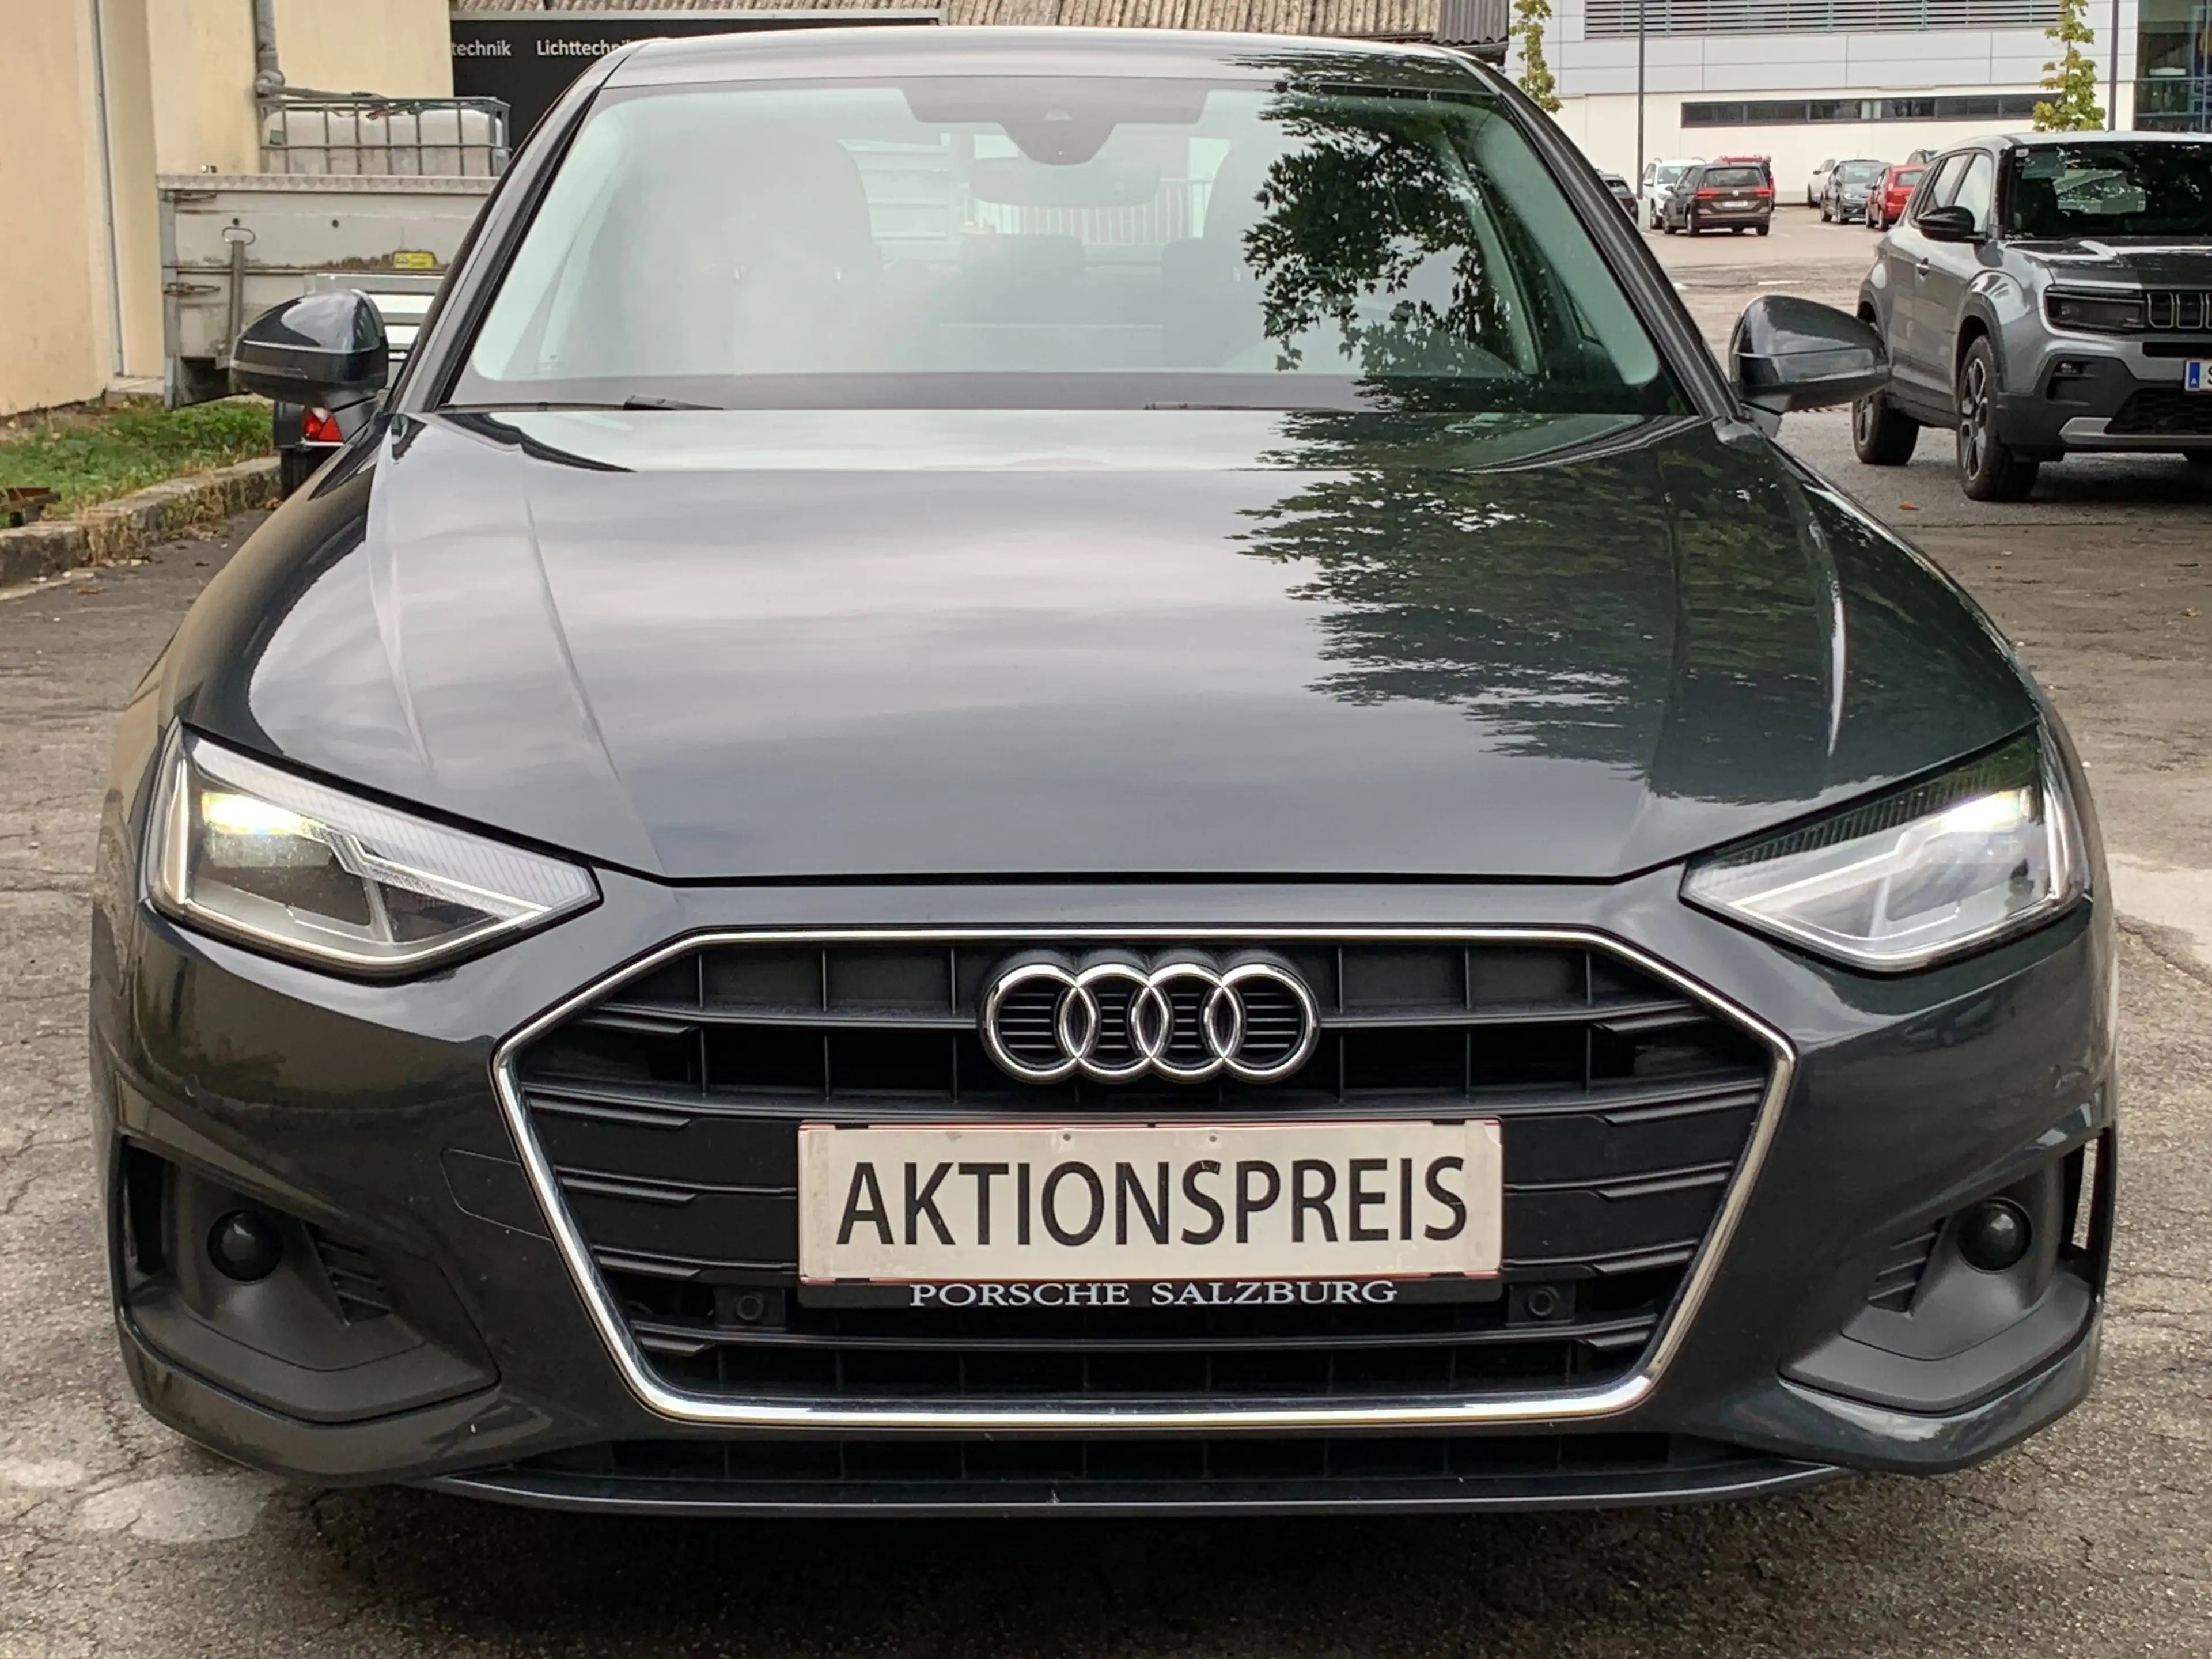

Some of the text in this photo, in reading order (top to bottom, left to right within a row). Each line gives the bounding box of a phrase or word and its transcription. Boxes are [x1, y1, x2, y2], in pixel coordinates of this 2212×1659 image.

[536, 39, 630, 56] Lichttech
[836, 1156, 1467, 1247] AKTIONSPREIS
[909, 1279, 1398, 1306] PORSCHE SALZBURG
